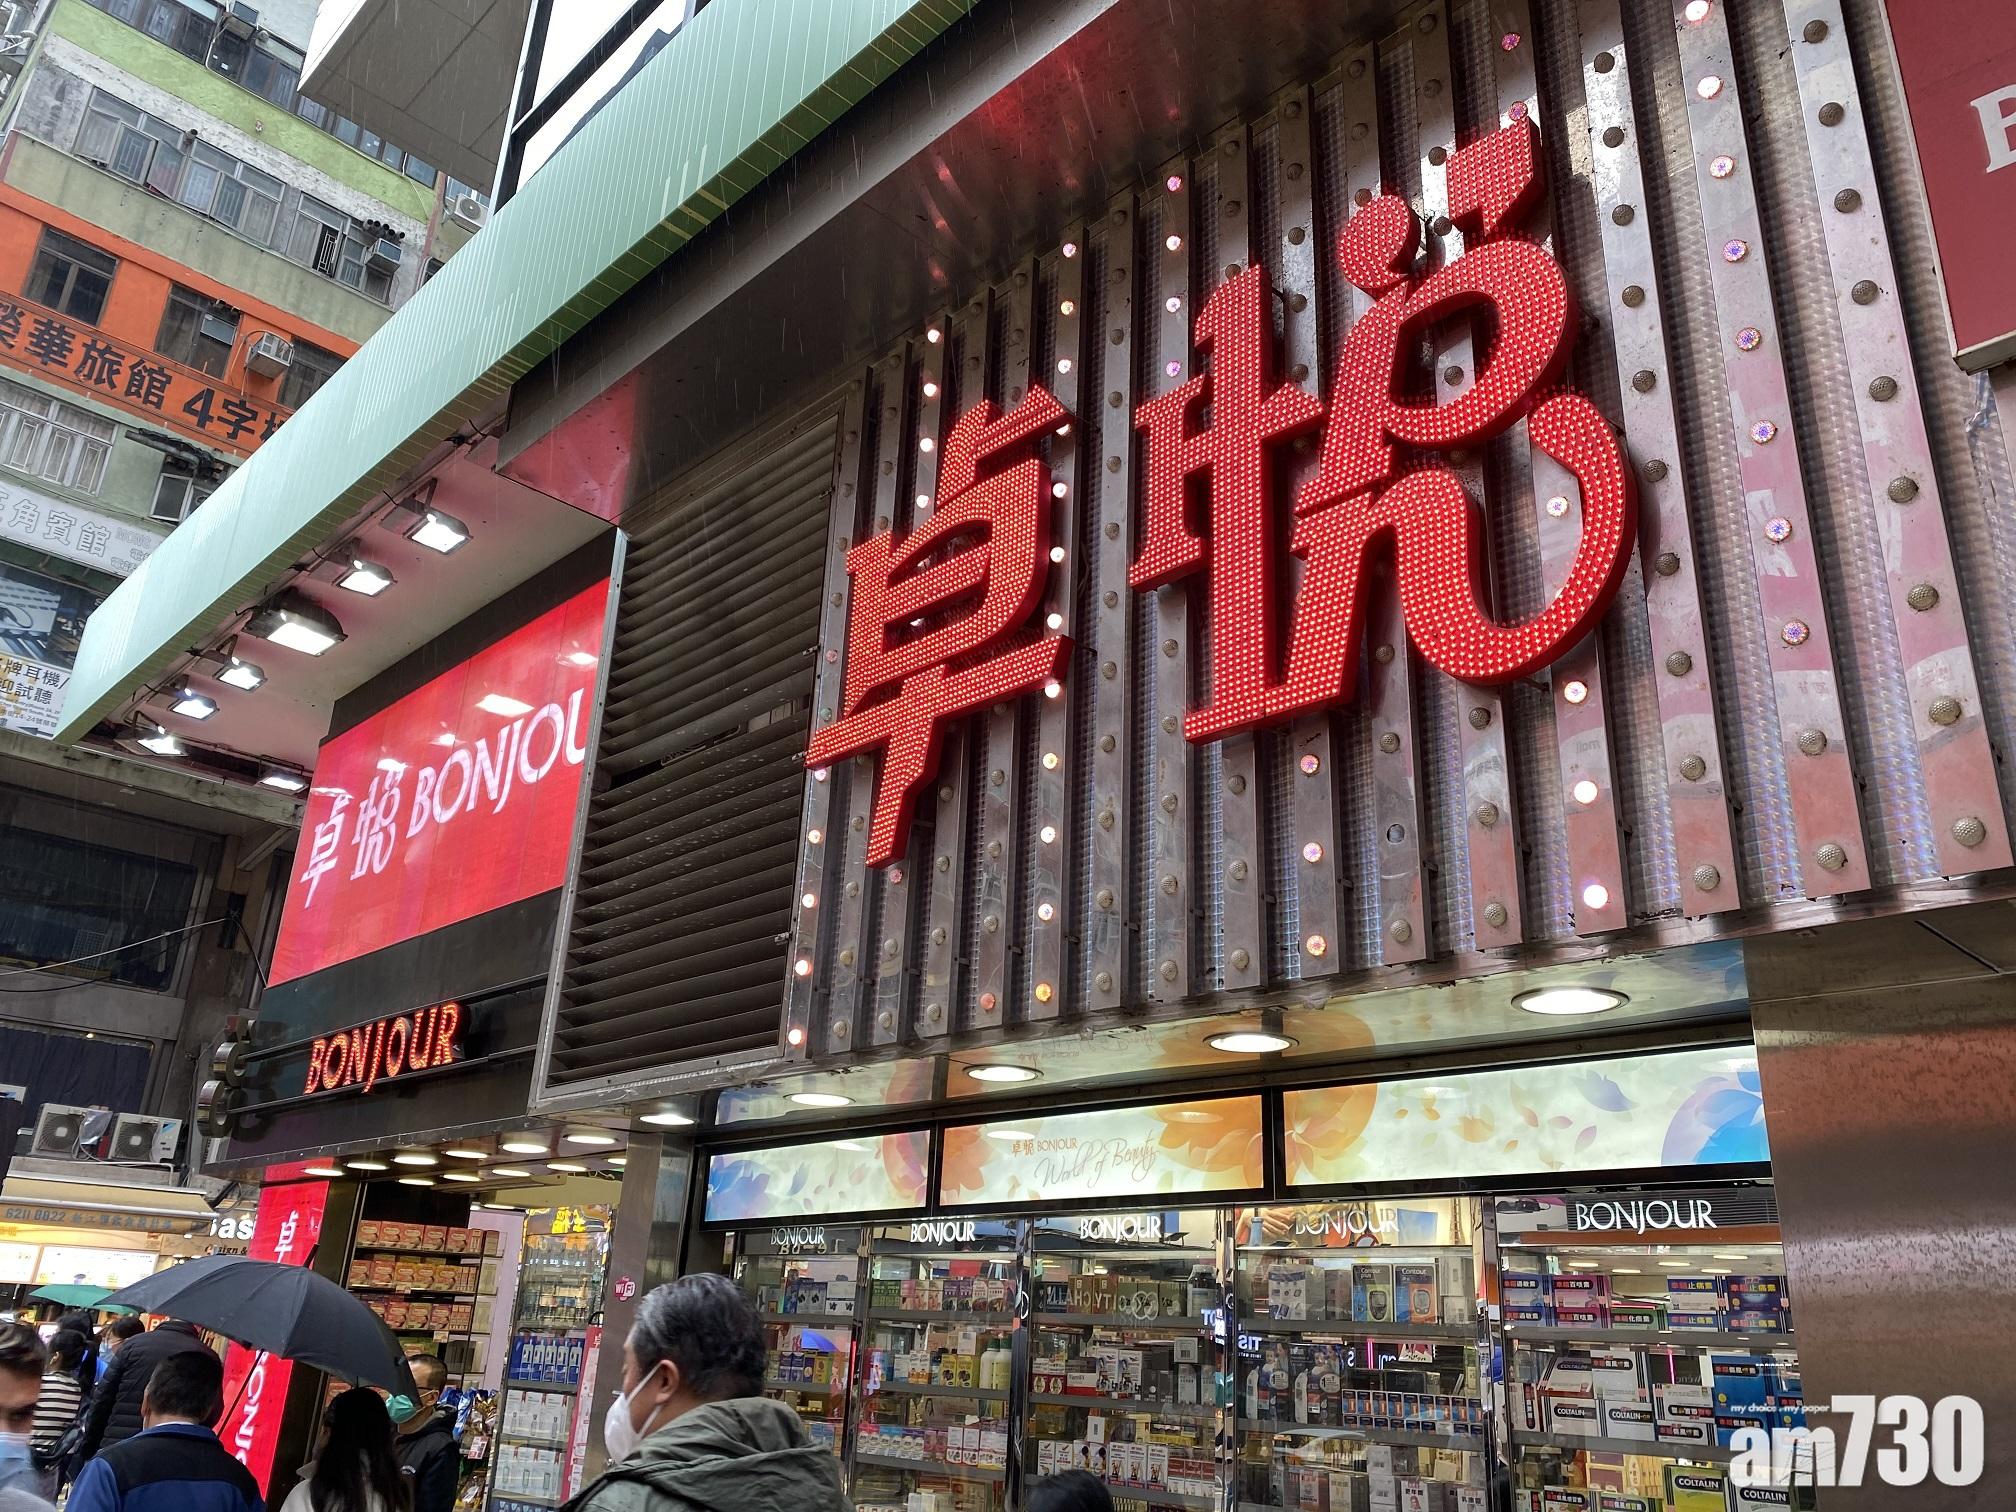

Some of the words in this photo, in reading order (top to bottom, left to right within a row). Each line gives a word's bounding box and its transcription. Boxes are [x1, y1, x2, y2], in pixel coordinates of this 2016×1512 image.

[0, 491, 112, 558] 角賓館
[303, 1001, 459, 1095] BONJOUR
[1037, 1138, 1078, 1152] BONJOUR
[1034, 1139, 1104, 1188] World
[1103, 1129, 1161, 1182] Beauty
[1080, 1214, 1162, 1241] BONJOUR
[1295, 1207, 1400, 1239] BONJOUR
[1576, 1198, 1718, 1235] BONJOUR
[770, 1226, 826, 1248] BONJOUR
[910, 1221, 976, 1246] BONJOUR
[1401, 1267, 1427, 1275] Contour
[1557, 1408, 1585, 1416] COLTALIN
[1678, 1478, 1719, 1489] COLTALIN
[1743, 1489, 1787, 1502] COLTALIN
